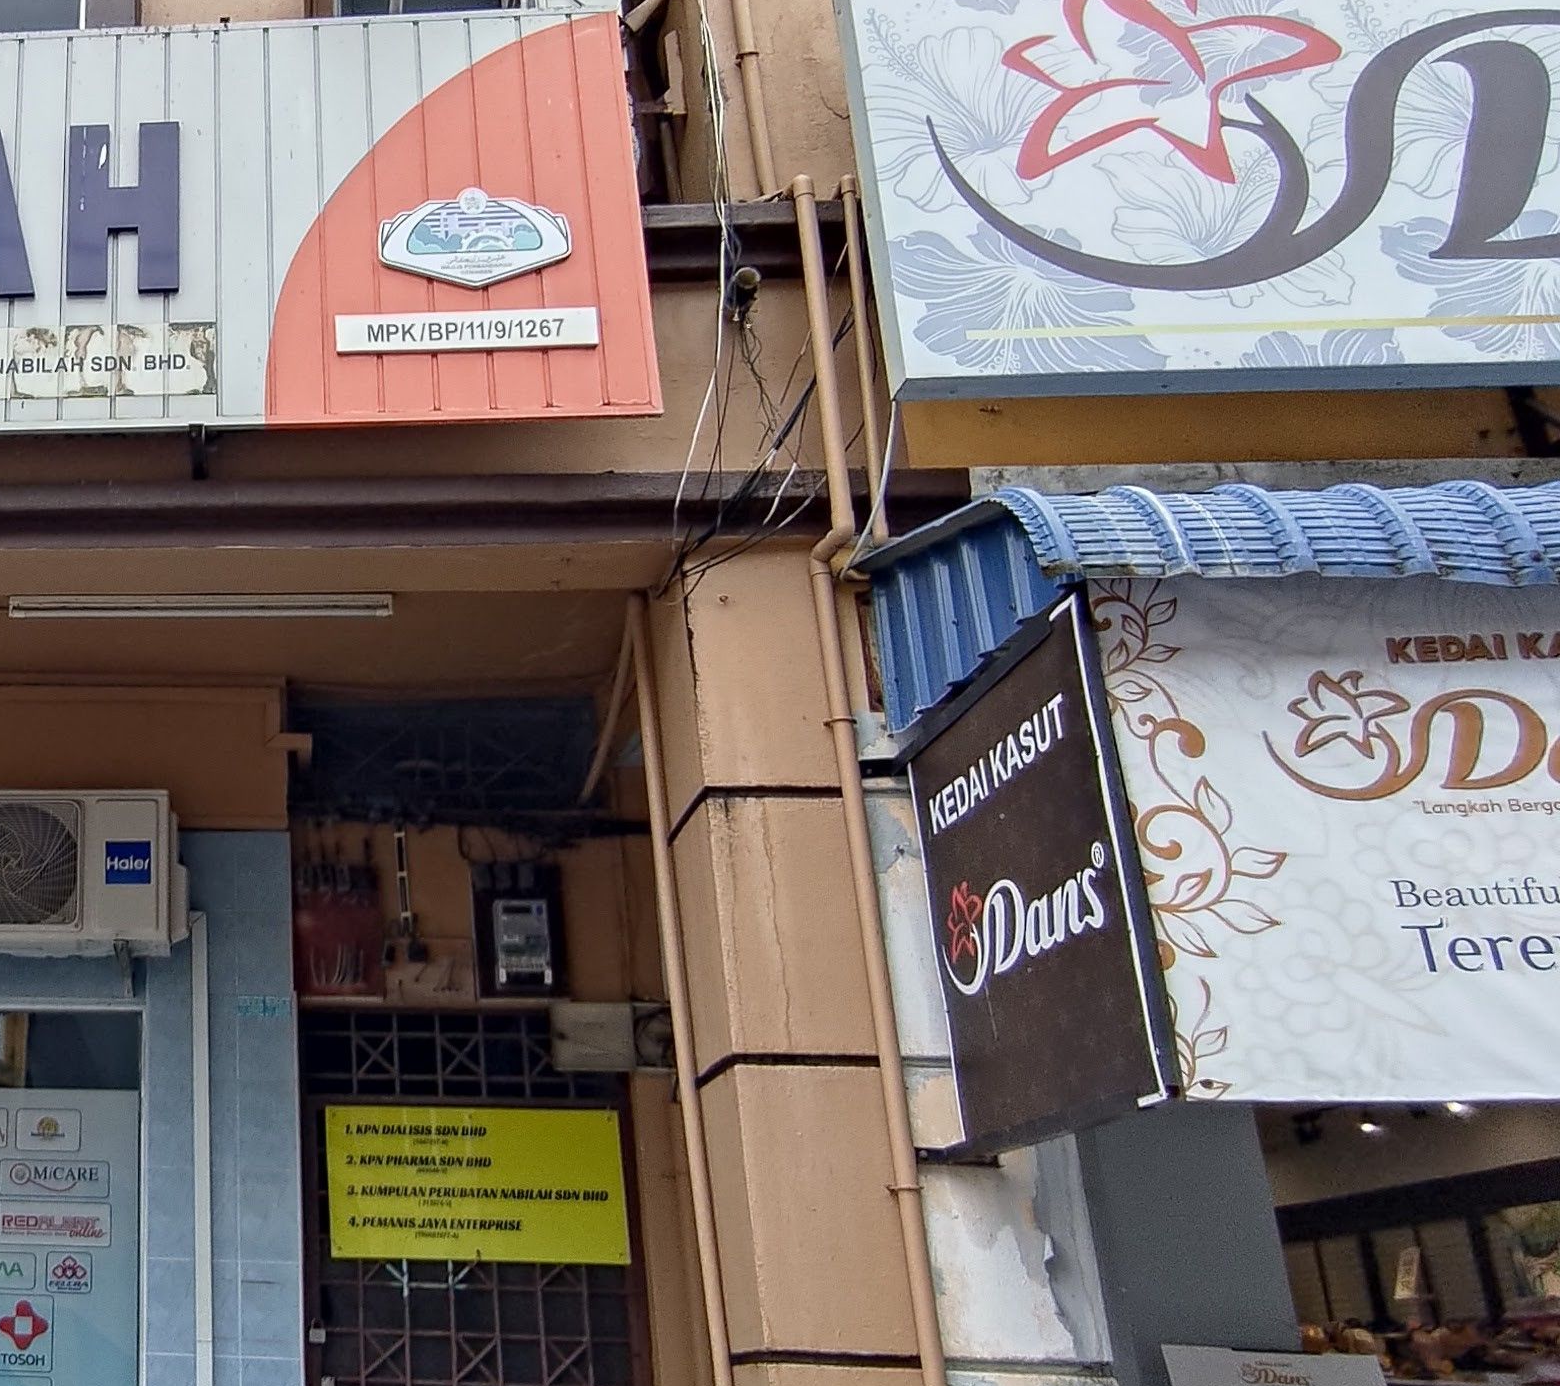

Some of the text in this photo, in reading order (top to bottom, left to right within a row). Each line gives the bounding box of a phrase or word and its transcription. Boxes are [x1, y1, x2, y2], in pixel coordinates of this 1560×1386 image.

[366, 318, 565, 344] MPK/BP/11/9/1267
[1386, 632, 1508, 663] KEDAI
[928, 693, 1066, 835] KEDAI KASUT
[106, 855, 151, 870] Haier
[1401, 918, 1560, 974] Tere
[361, 1186, 428, 1198] KUMPULAN
[429, 1187, 498, 1200] PERUBATAN
[362, 1217, 416, 1229] PEMANIS
[417, 1218, 448, 1229] JAYA
[449, 1218, 523, 1231] ENTERPRISE
[1, 1353, 46, 1367] TOSOH
